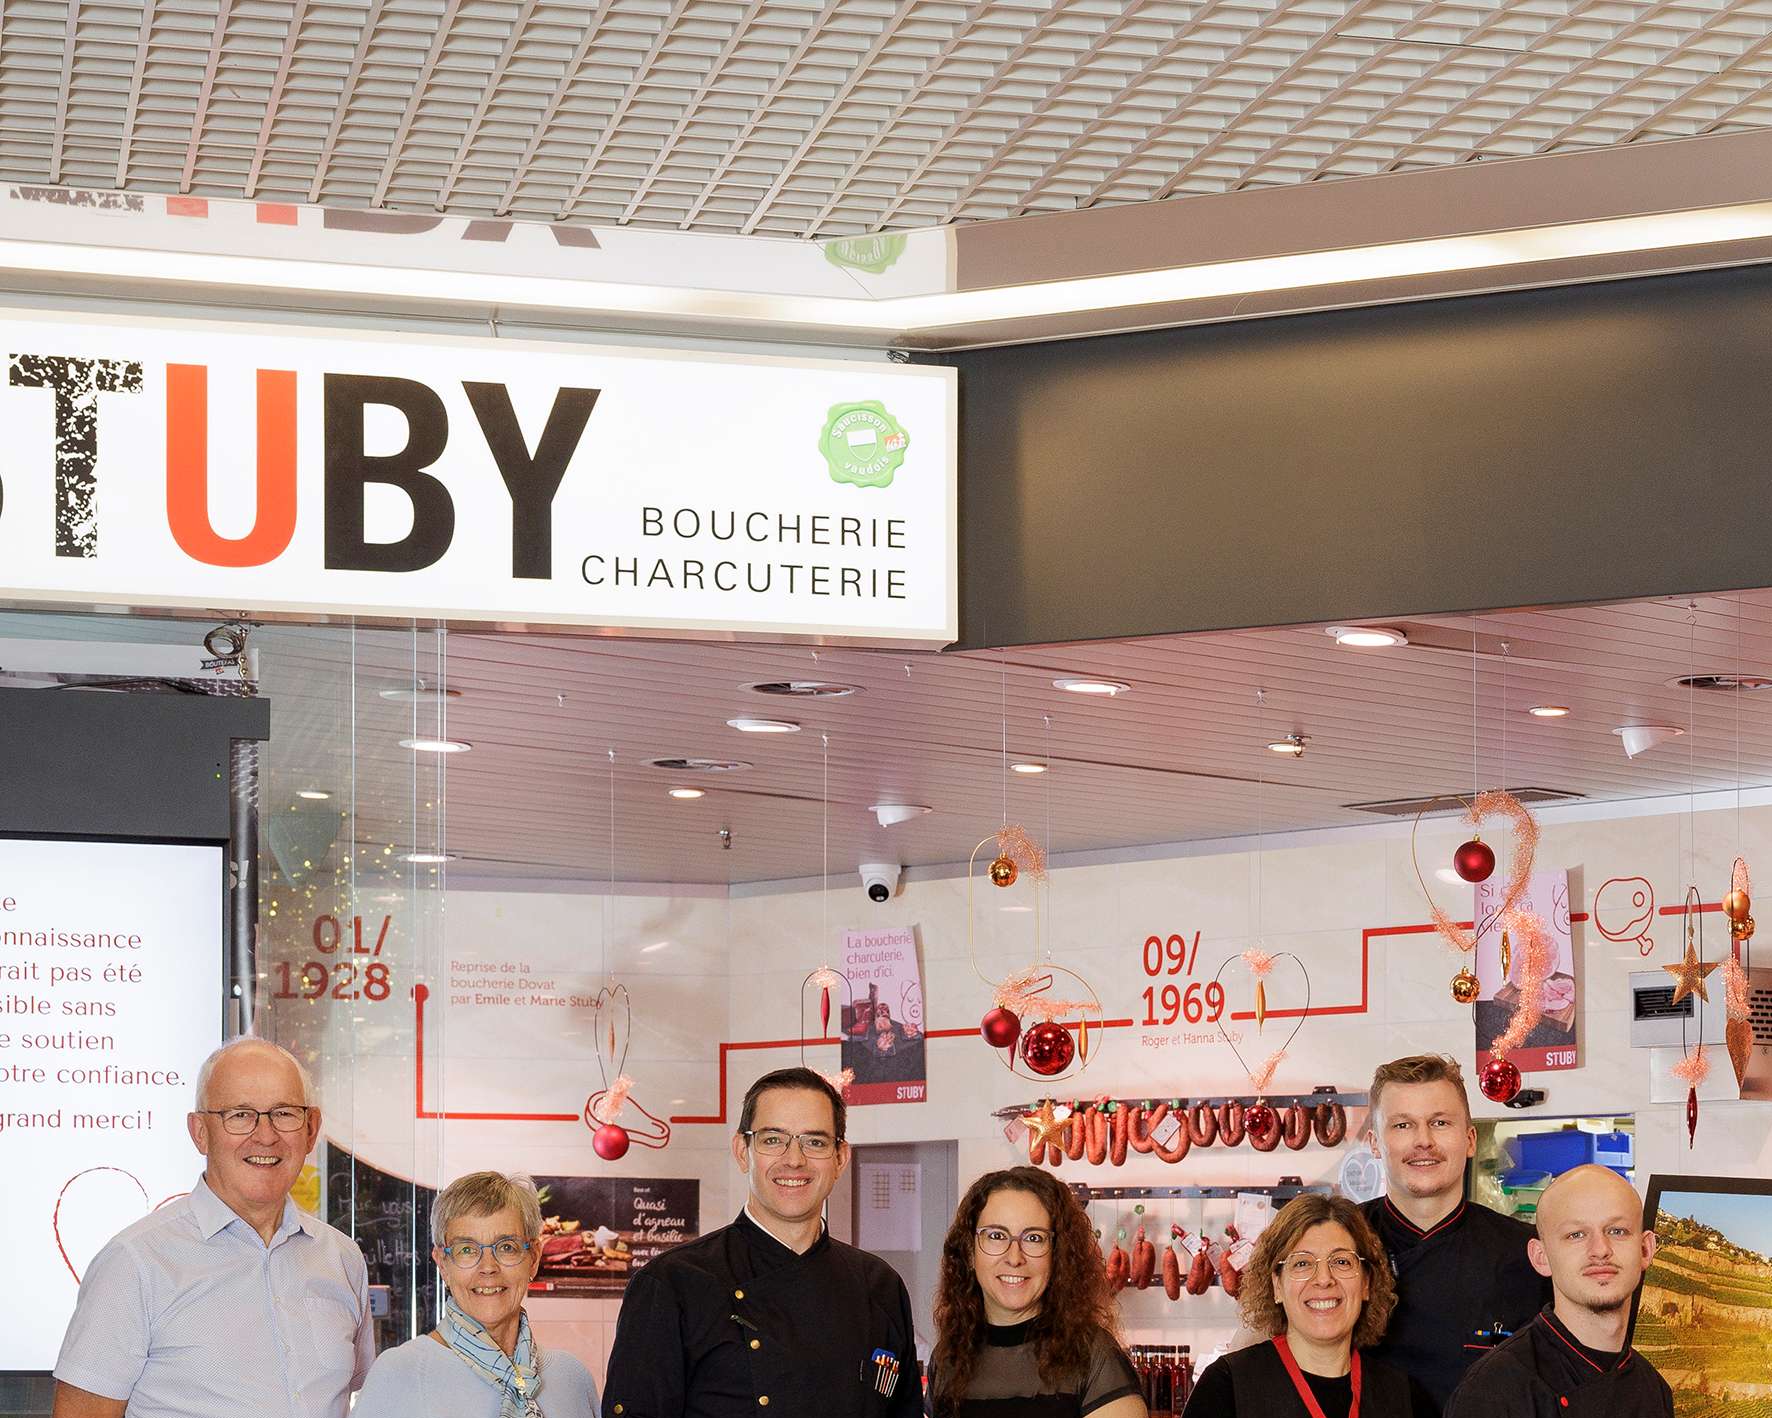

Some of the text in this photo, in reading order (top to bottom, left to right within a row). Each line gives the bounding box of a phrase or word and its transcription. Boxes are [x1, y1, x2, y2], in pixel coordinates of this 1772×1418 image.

[831, 412, 888, 439] Saucisson
[0, 353, 602, 580] TUBY
[642, 507, 906, 549] BOUCHERIE
[581, 555, 906, 599] CHARCUTERIE
[1480, 883, 1494, 898] Si
[0, 928, 142, 949] nnaissance
[313, 915, 392, 957] 01/
[847, 931, 912, 949] La boucherie
[846, 950, 905, 965] charcuterie,
[1143, 931, 1201, 976] 09/
[50, 965, 92, 987] pas
[103, 963, 142, 983] été
[451, 960, 531, 975] Reprise de la
[847, 967, 895, 980] bien d'ici.
[272, 960, 392, 1002] 1928
[450, 977, 557, 990] boucherie Dovat
[62, 1000, 116, 1017] sans
[451, 993, 604, 1009] par Emile et Marie Stuby
[1142, 981, 1225, 1027] 1969
[22, 1030, 114, 1050] soutien
[1142, 1034, 1169, 1049] Roger
[1172, 1033, 1181, 1046] et
[1183, 1032, 1215, 1045] Hanna
[1546, 1051, 1576, 1066] STUBY
[57, 1065, 186, 1086] confiance.
[896, 1085, 925, 1100] STUBY
[73, 1110, 152, 1130] merci!
[633, 1197, 668, 1211] Quasi
[632, 1212, 685, 1231] d'agneau
[632, 1228, 684, 1243] et basilic
